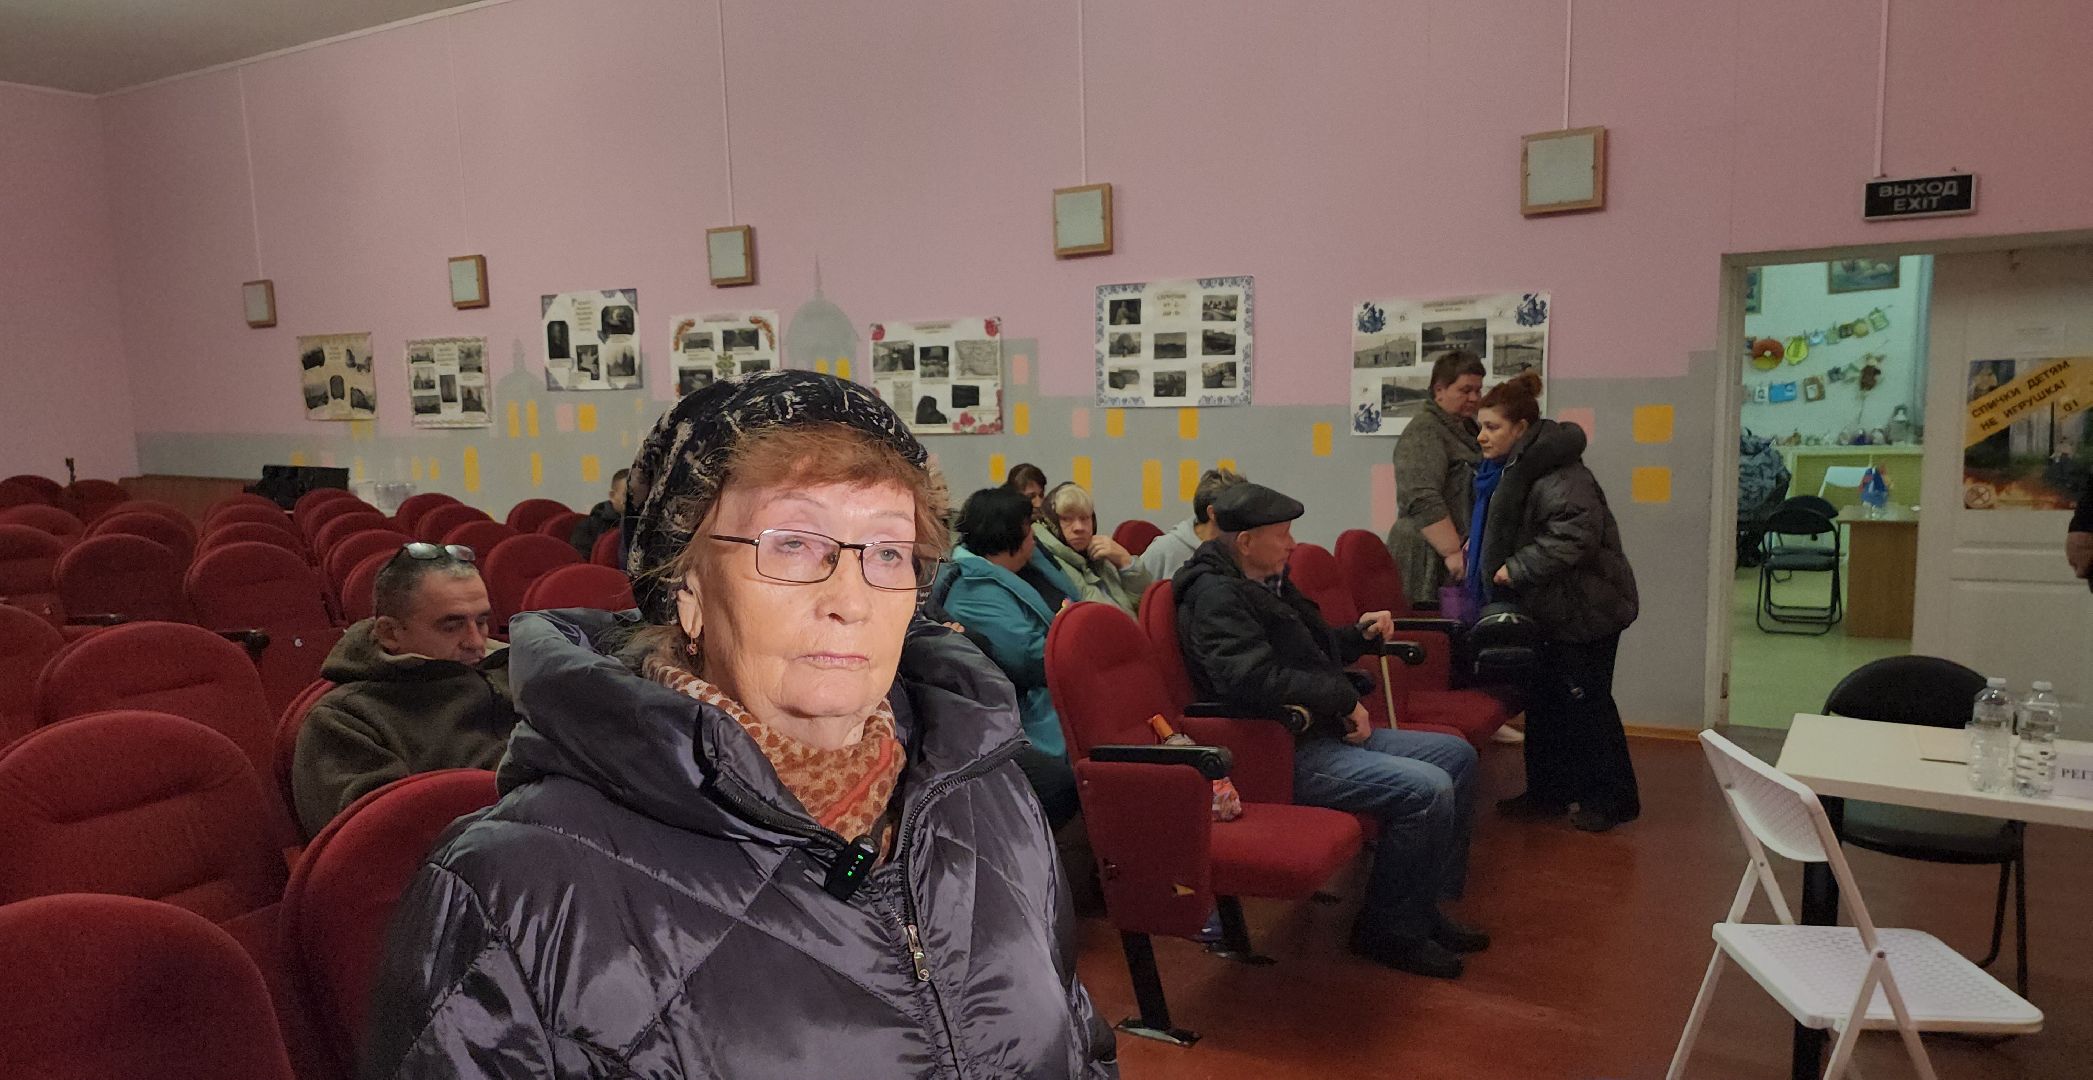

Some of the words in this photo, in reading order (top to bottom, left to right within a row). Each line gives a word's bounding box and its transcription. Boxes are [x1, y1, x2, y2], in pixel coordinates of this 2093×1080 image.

[1880, 181, 1958, 197] ВЫХОД
[1893, 196, 1940, 211] EXIT
[1972, 387, 2021, 418] СПИЧКИ
[2027, 360, 2070, 390] ДЕТЯМ
[1980, 416, 1998, 430] НЕ
[2003, 379, 2066, 418] ИГРУШКА!
